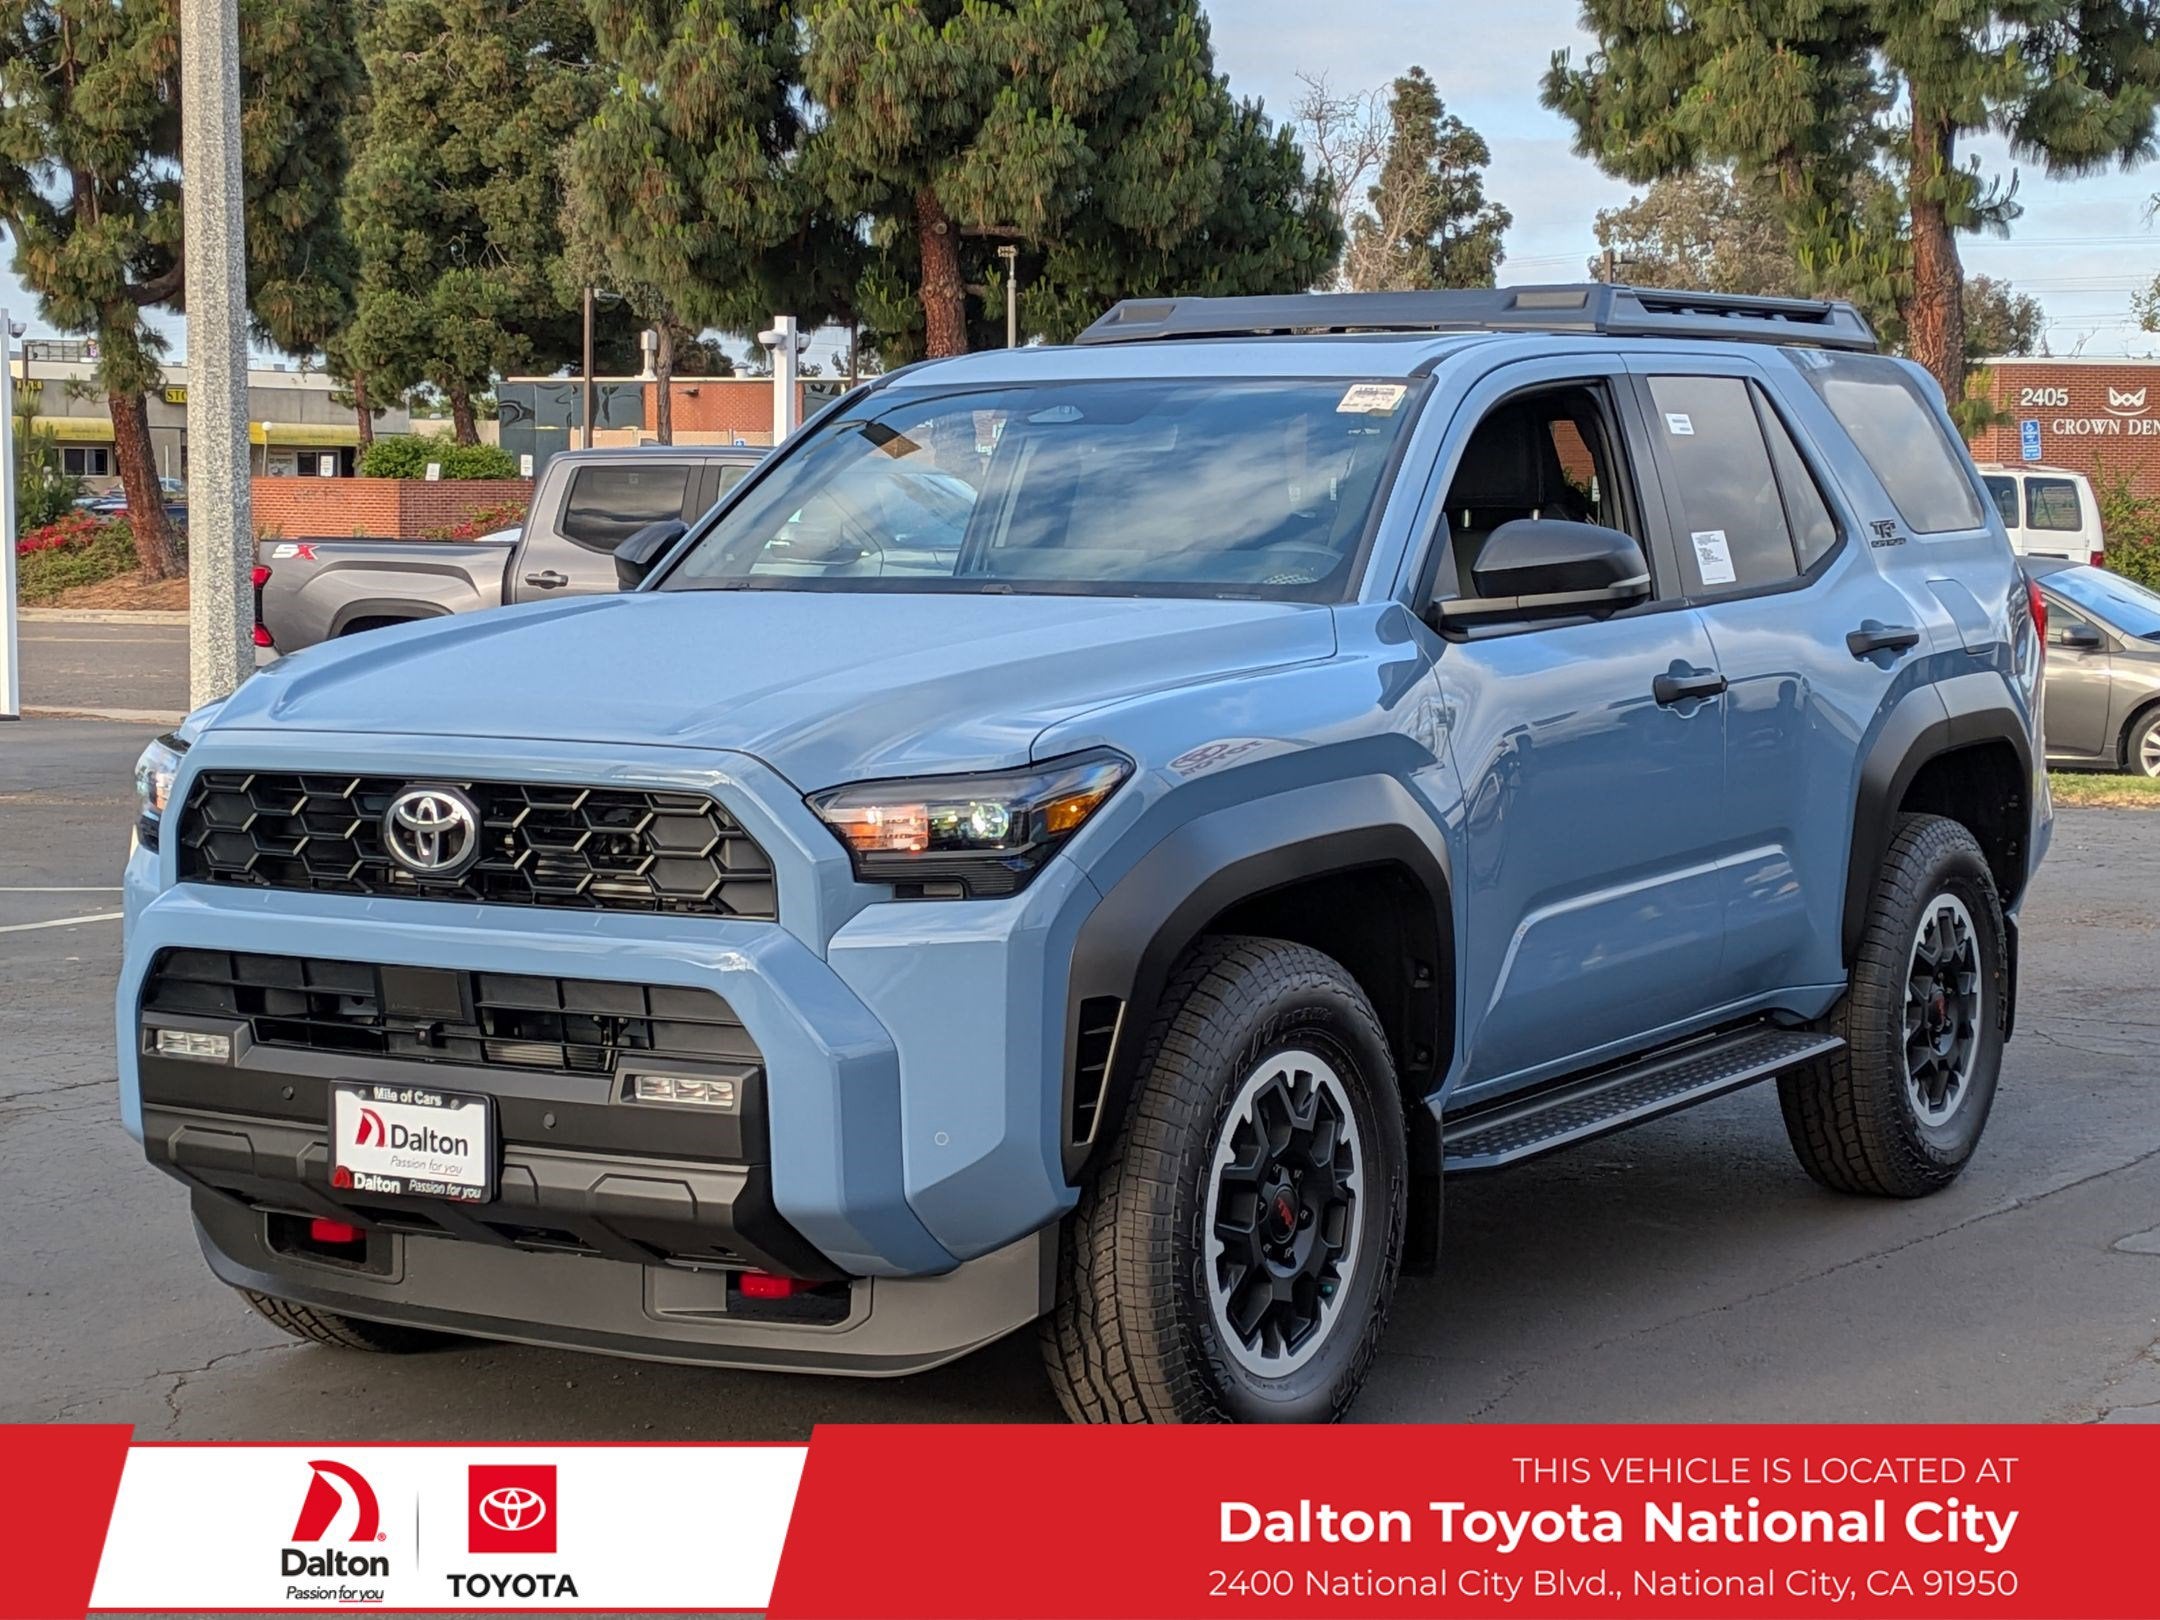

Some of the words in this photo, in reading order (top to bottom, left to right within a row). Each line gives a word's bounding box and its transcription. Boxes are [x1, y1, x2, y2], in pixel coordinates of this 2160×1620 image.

[2020, 388, 2069, 407] 2405
[2052, 418, 2121, 436] CROWN
[373, 1086, 398, 1102] Mile
[400, 1089, 413, 1102] of
[414, 1089, 442, 1106] Cars
[390, 1123, 468, 1157] Dalton
[390, 1155, 427, 1171] Passion
[428, 1159, 443, 1173] for
[443, 1164, 463, 1176] you
[353, 1172, 401, 1194] Dalton
[408, 1179, 445, 1195] Passion
[445, 1183, 462, 1197] for
[461, 1187, 482, 1200] you
